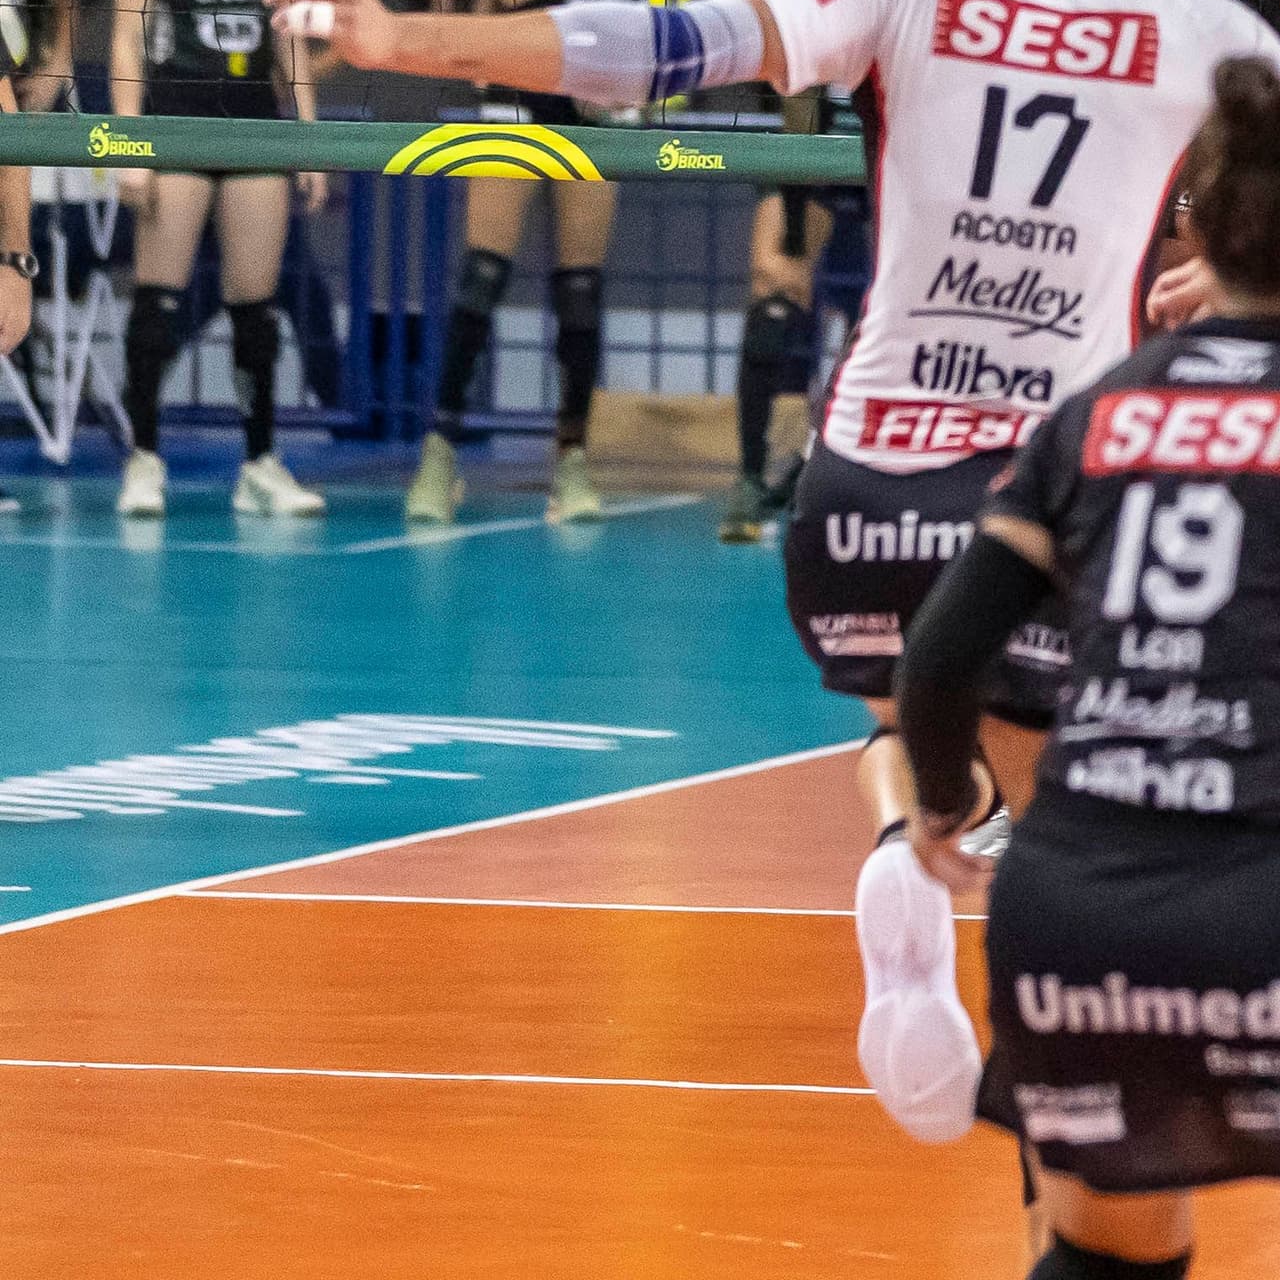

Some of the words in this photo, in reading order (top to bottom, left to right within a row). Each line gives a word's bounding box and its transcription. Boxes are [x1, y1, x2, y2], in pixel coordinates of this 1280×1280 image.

[110, 141, 156, 157] BRASIL
[679, 155, 726, 170] BRASIL
[970, 84, 1093, 208] 17
[950, 209, 1078, 255] ACOSTA
[911, 339, 1053, 402] tilibra
[826, 508, 976, 563] Unim
[1102, 480, 1245, 626] 19
